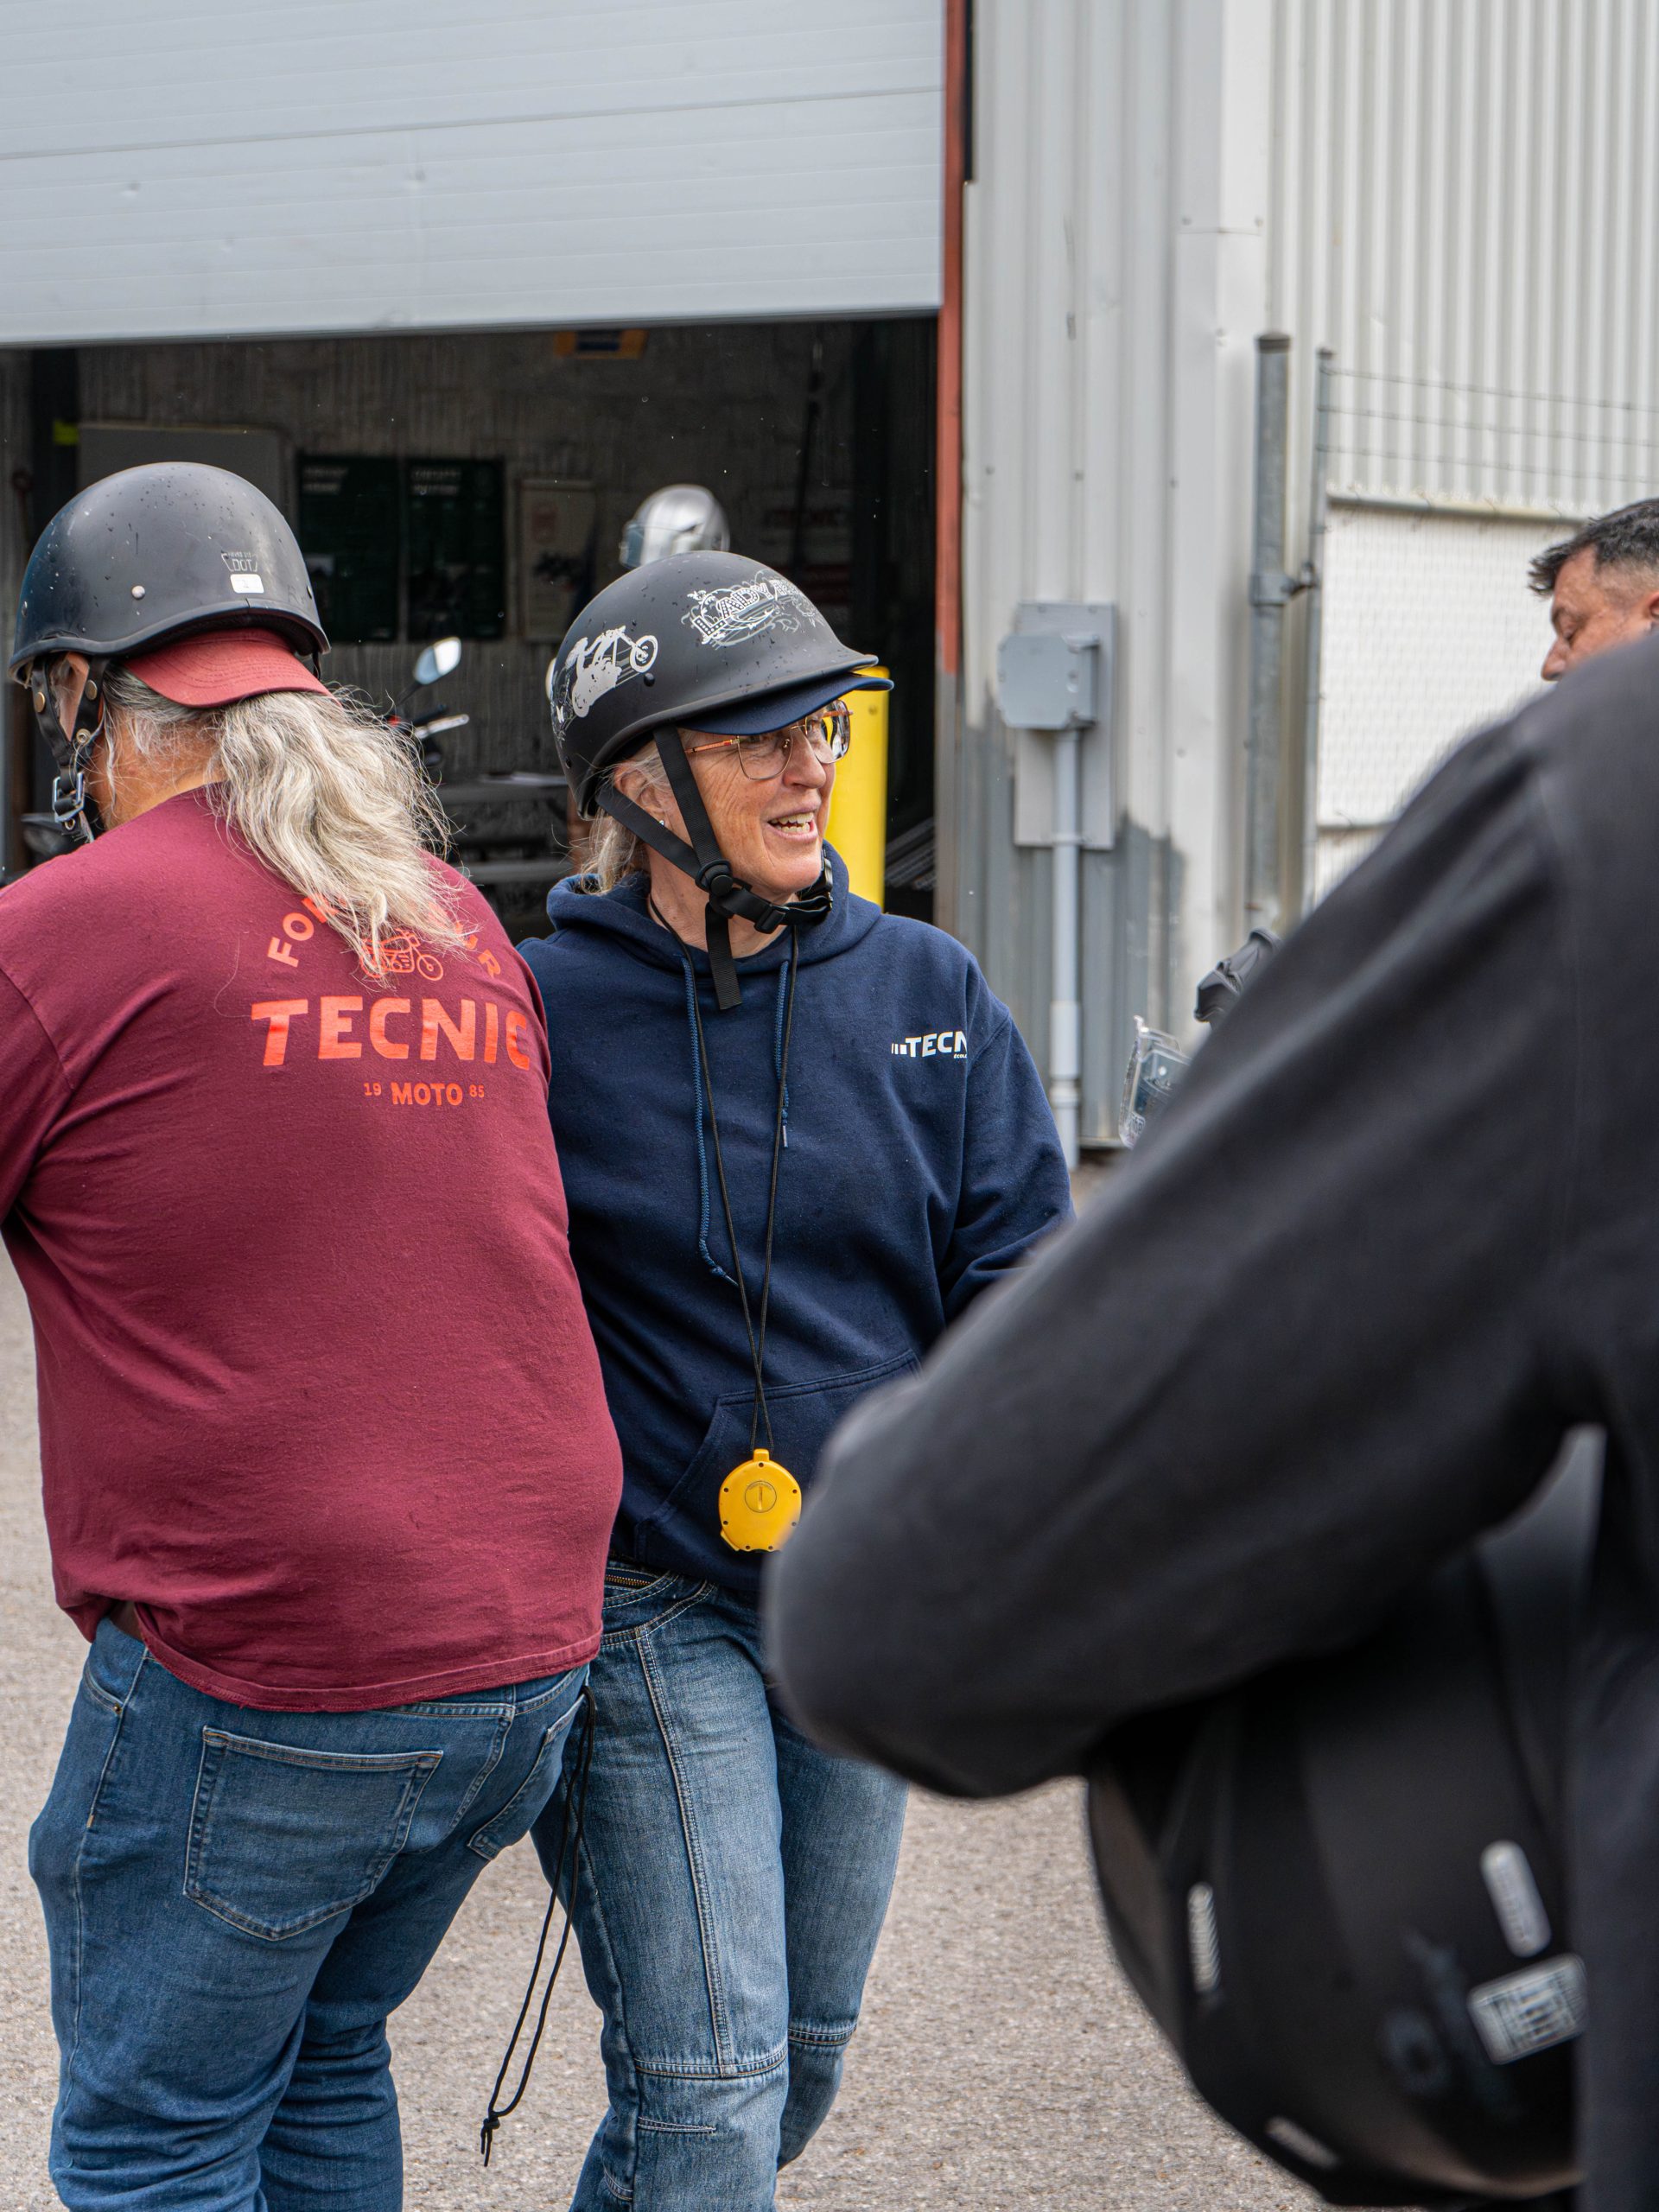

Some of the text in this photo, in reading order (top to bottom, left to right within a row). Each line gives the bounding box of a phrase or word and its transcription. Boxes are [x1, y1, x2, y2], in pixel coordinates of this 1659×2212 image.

[251, 996, 531, 1071] TECNIC
[364, 1083, 485, 1106] 19 MOTO 85
